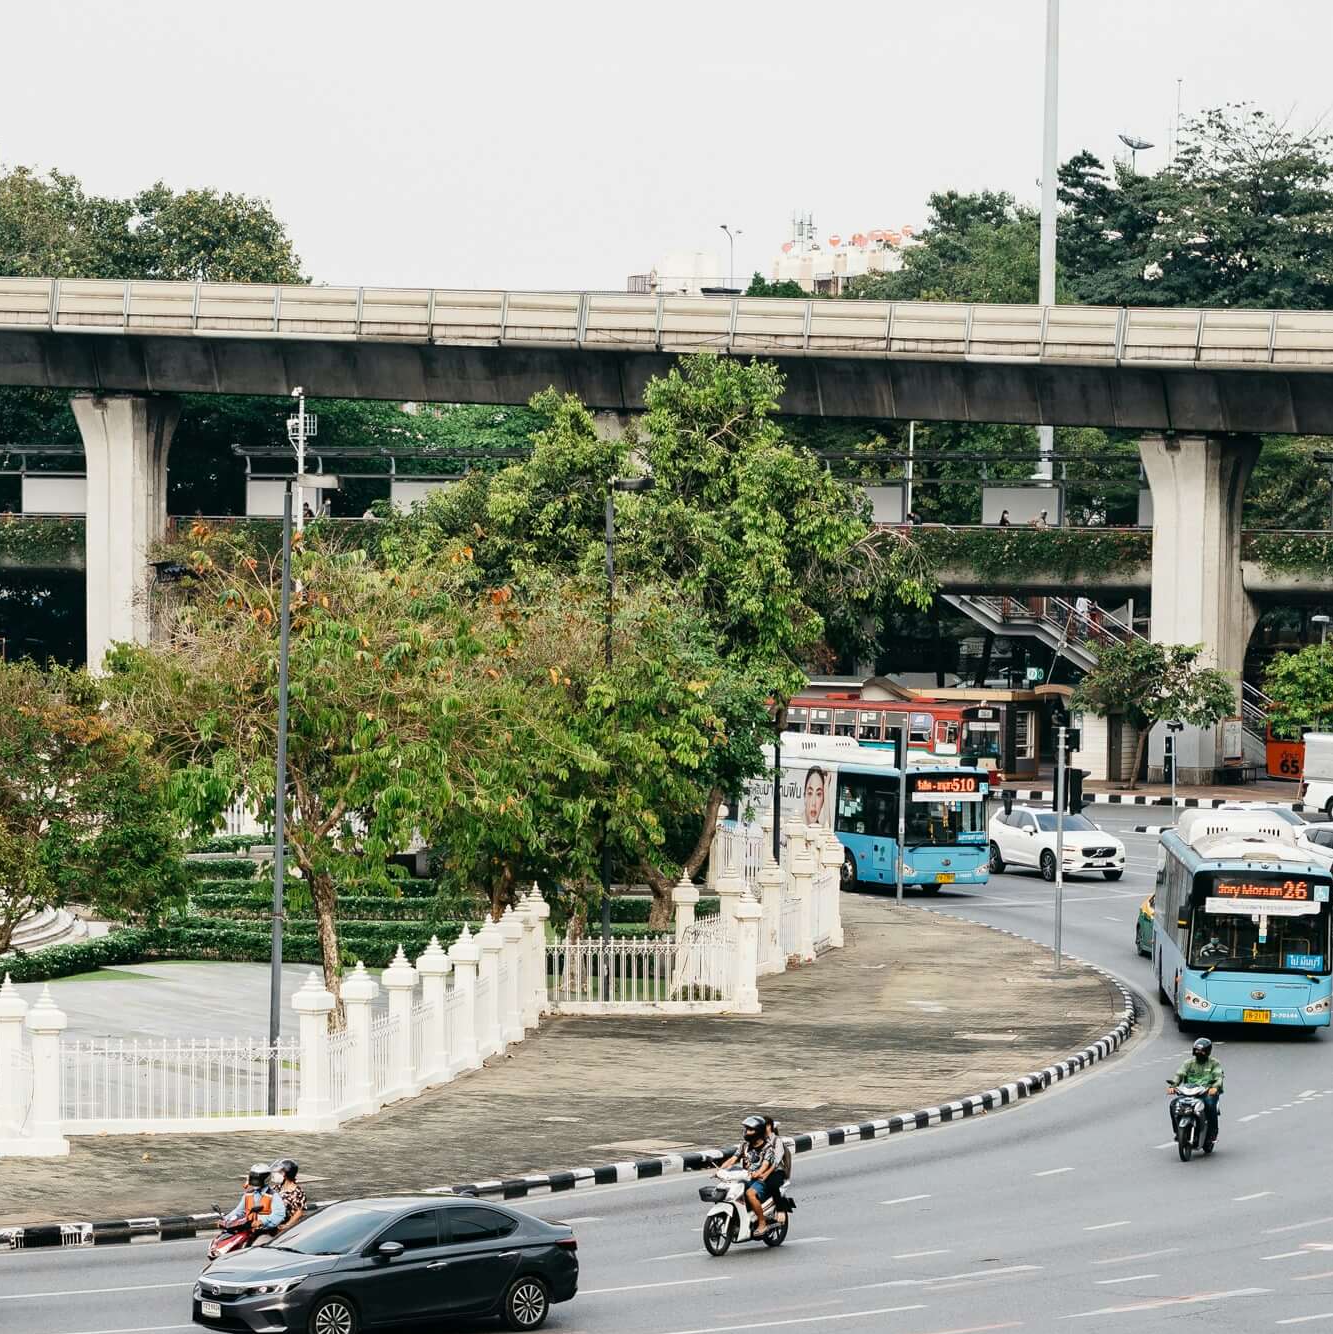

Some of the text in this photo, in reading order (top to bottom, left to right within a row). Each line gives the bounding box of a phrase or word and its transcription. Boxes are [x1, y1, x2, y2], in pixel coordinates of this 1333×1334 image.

[1280, 760, 1300, 774] 65
[953, 778, 975, 792] 510
[1282, 880, 1308, 899] 26
